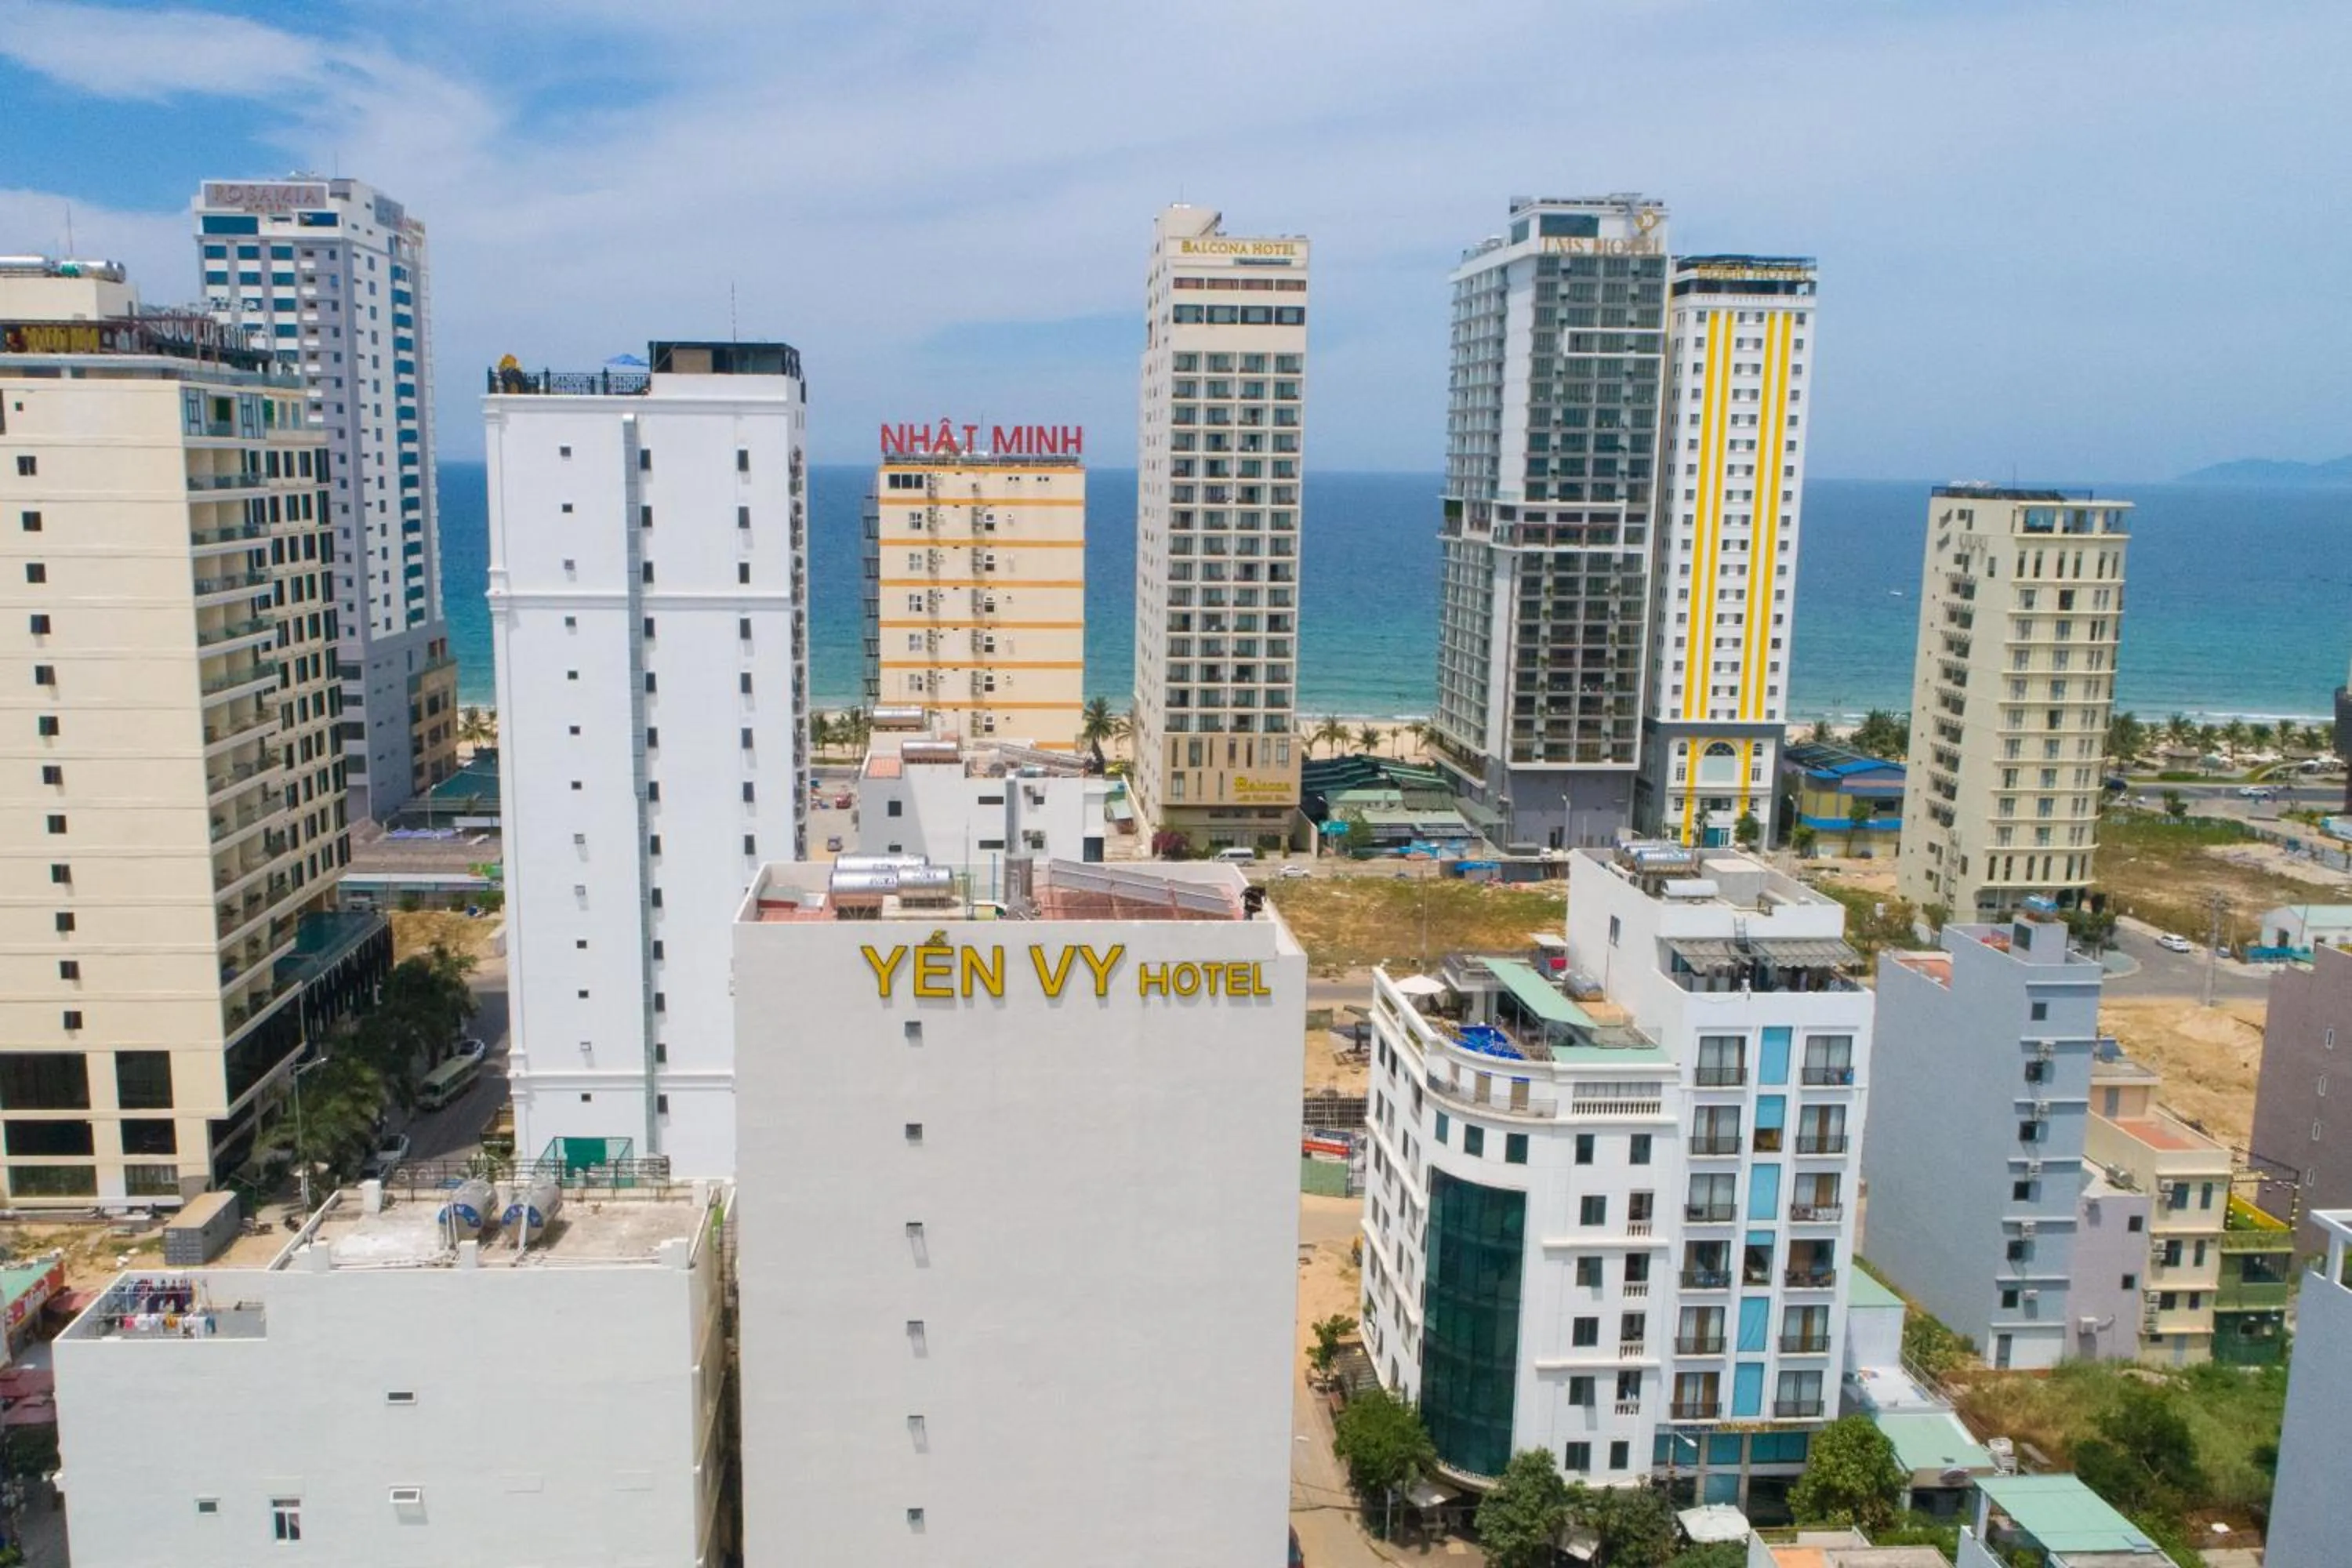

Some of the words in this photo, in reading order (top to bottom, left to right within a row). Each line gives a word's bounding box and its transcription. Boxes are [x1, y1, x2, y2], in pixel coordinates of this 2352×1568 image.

[1181, 240, 1248, 254] BALCONA
[1253, 242, 1298, 256] HOTEL
[993, 425, 1083, 454] MINH
[1029, 943, 1125, 998] VY
[1138, 961, 1272, 996] HOTEL
